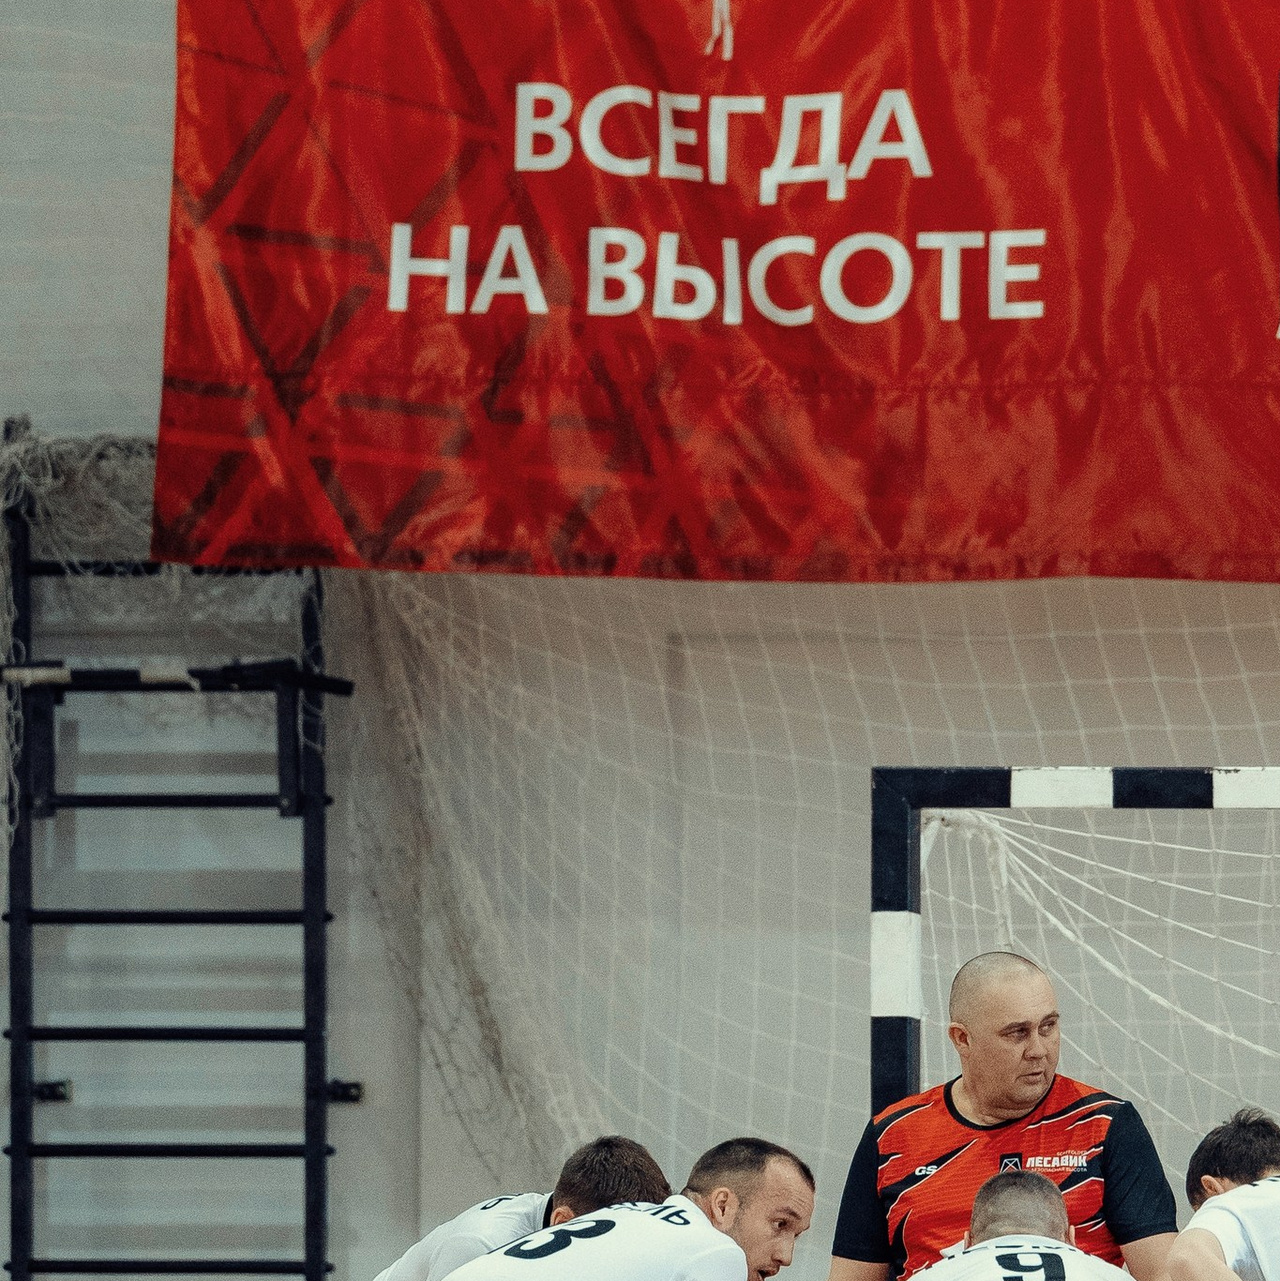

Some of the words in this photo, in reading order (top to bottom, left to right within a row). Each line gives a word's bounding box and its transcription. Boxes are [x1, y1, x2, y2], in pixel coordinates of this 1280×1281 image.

[514, 81, 934, 206] ВСЕГДА
[386, 223, 550, 315] НА
[586, 226, 1047, 327] ВЫСОТЕ
[915, 1165, 938, 1176] GS
[1026, 1155, 1088, 1168] ЛЕСАВИК
